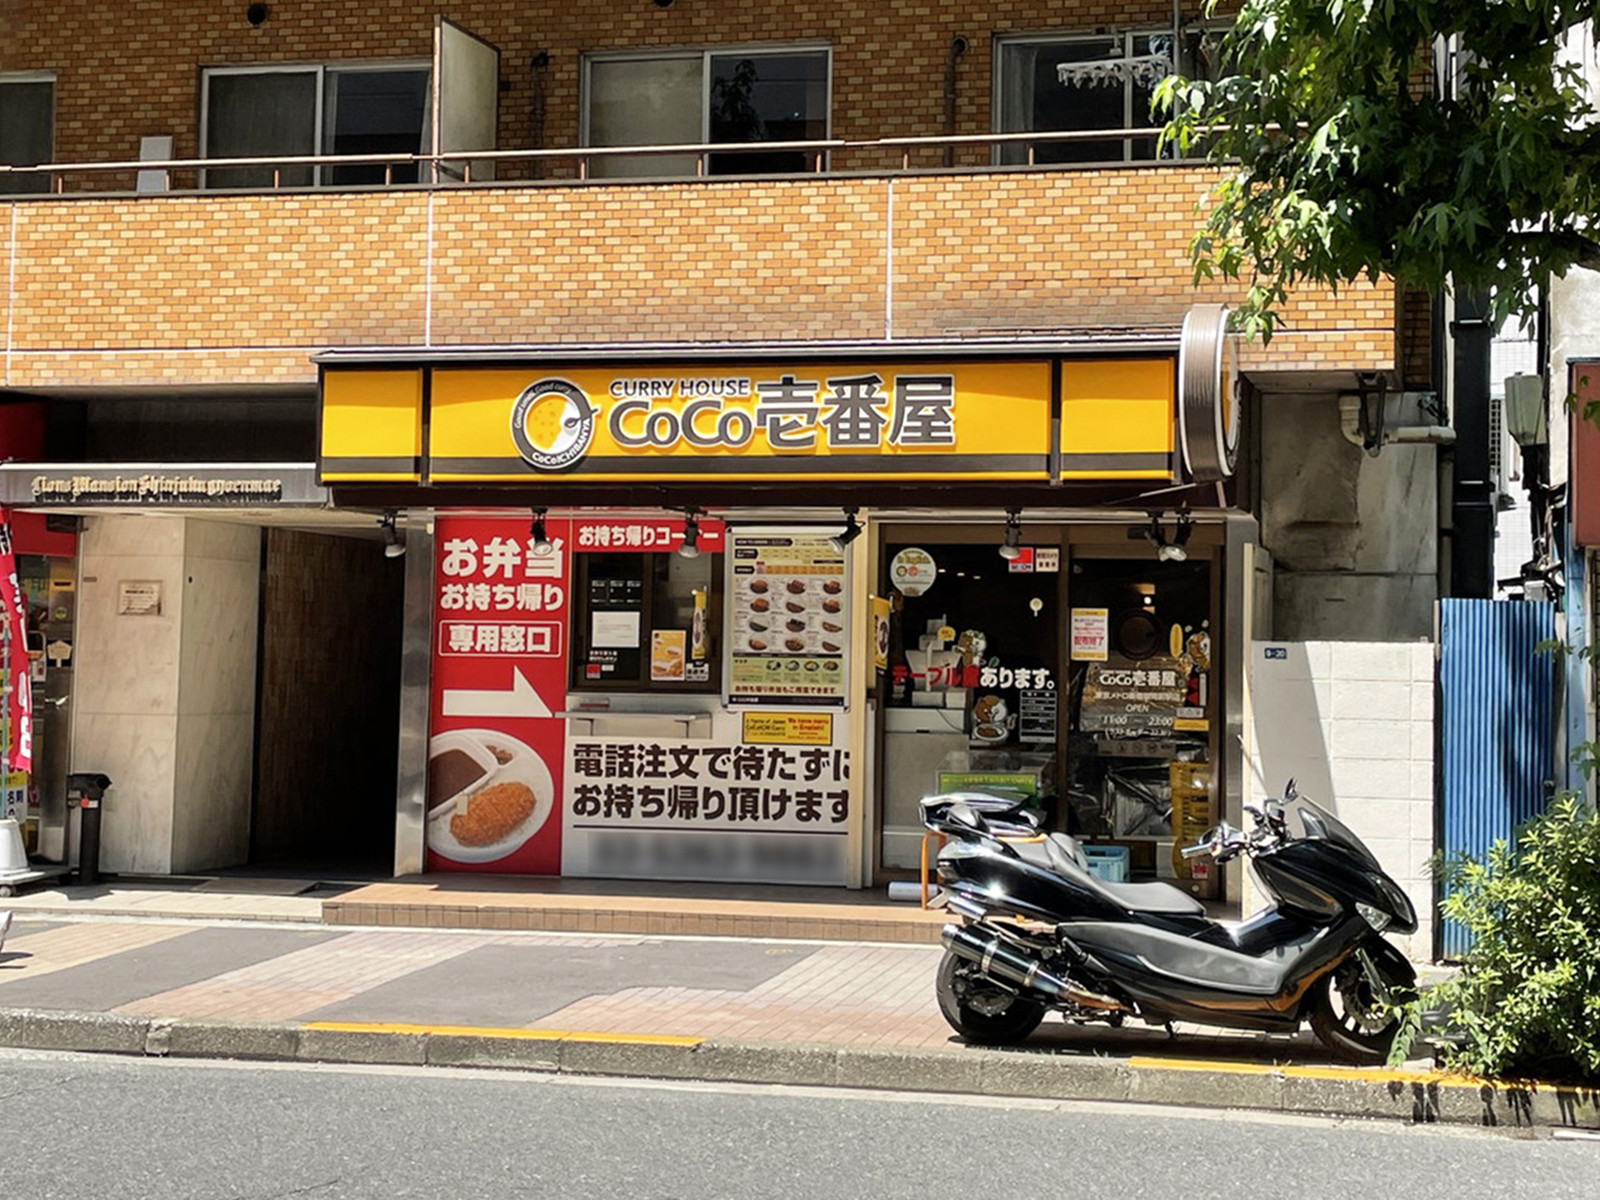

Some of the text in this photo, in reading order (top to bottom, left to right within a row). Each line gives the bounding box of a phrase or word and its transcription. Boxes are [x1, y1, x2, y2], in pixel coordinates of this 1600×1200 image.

[610, 378, 750, 397] CURRY HOUSE
[609, 375, 955, 448] CoCo壱番屋
[71, 475, 139, 495] Mansion
[579, 525, 719, 546] お持ち帰りコーー
[442, 537, 565, 579] お弁当
[440, 583, 564, 611] お持ち帰り
[449, 625, 552, 653] 専用窓口
[1125, 703, 1149, 712] OPEN
[573, 744, 850, 781] 電話注文で待たずに
[572, 784, 849, 823] お持ち帰り頂けます
